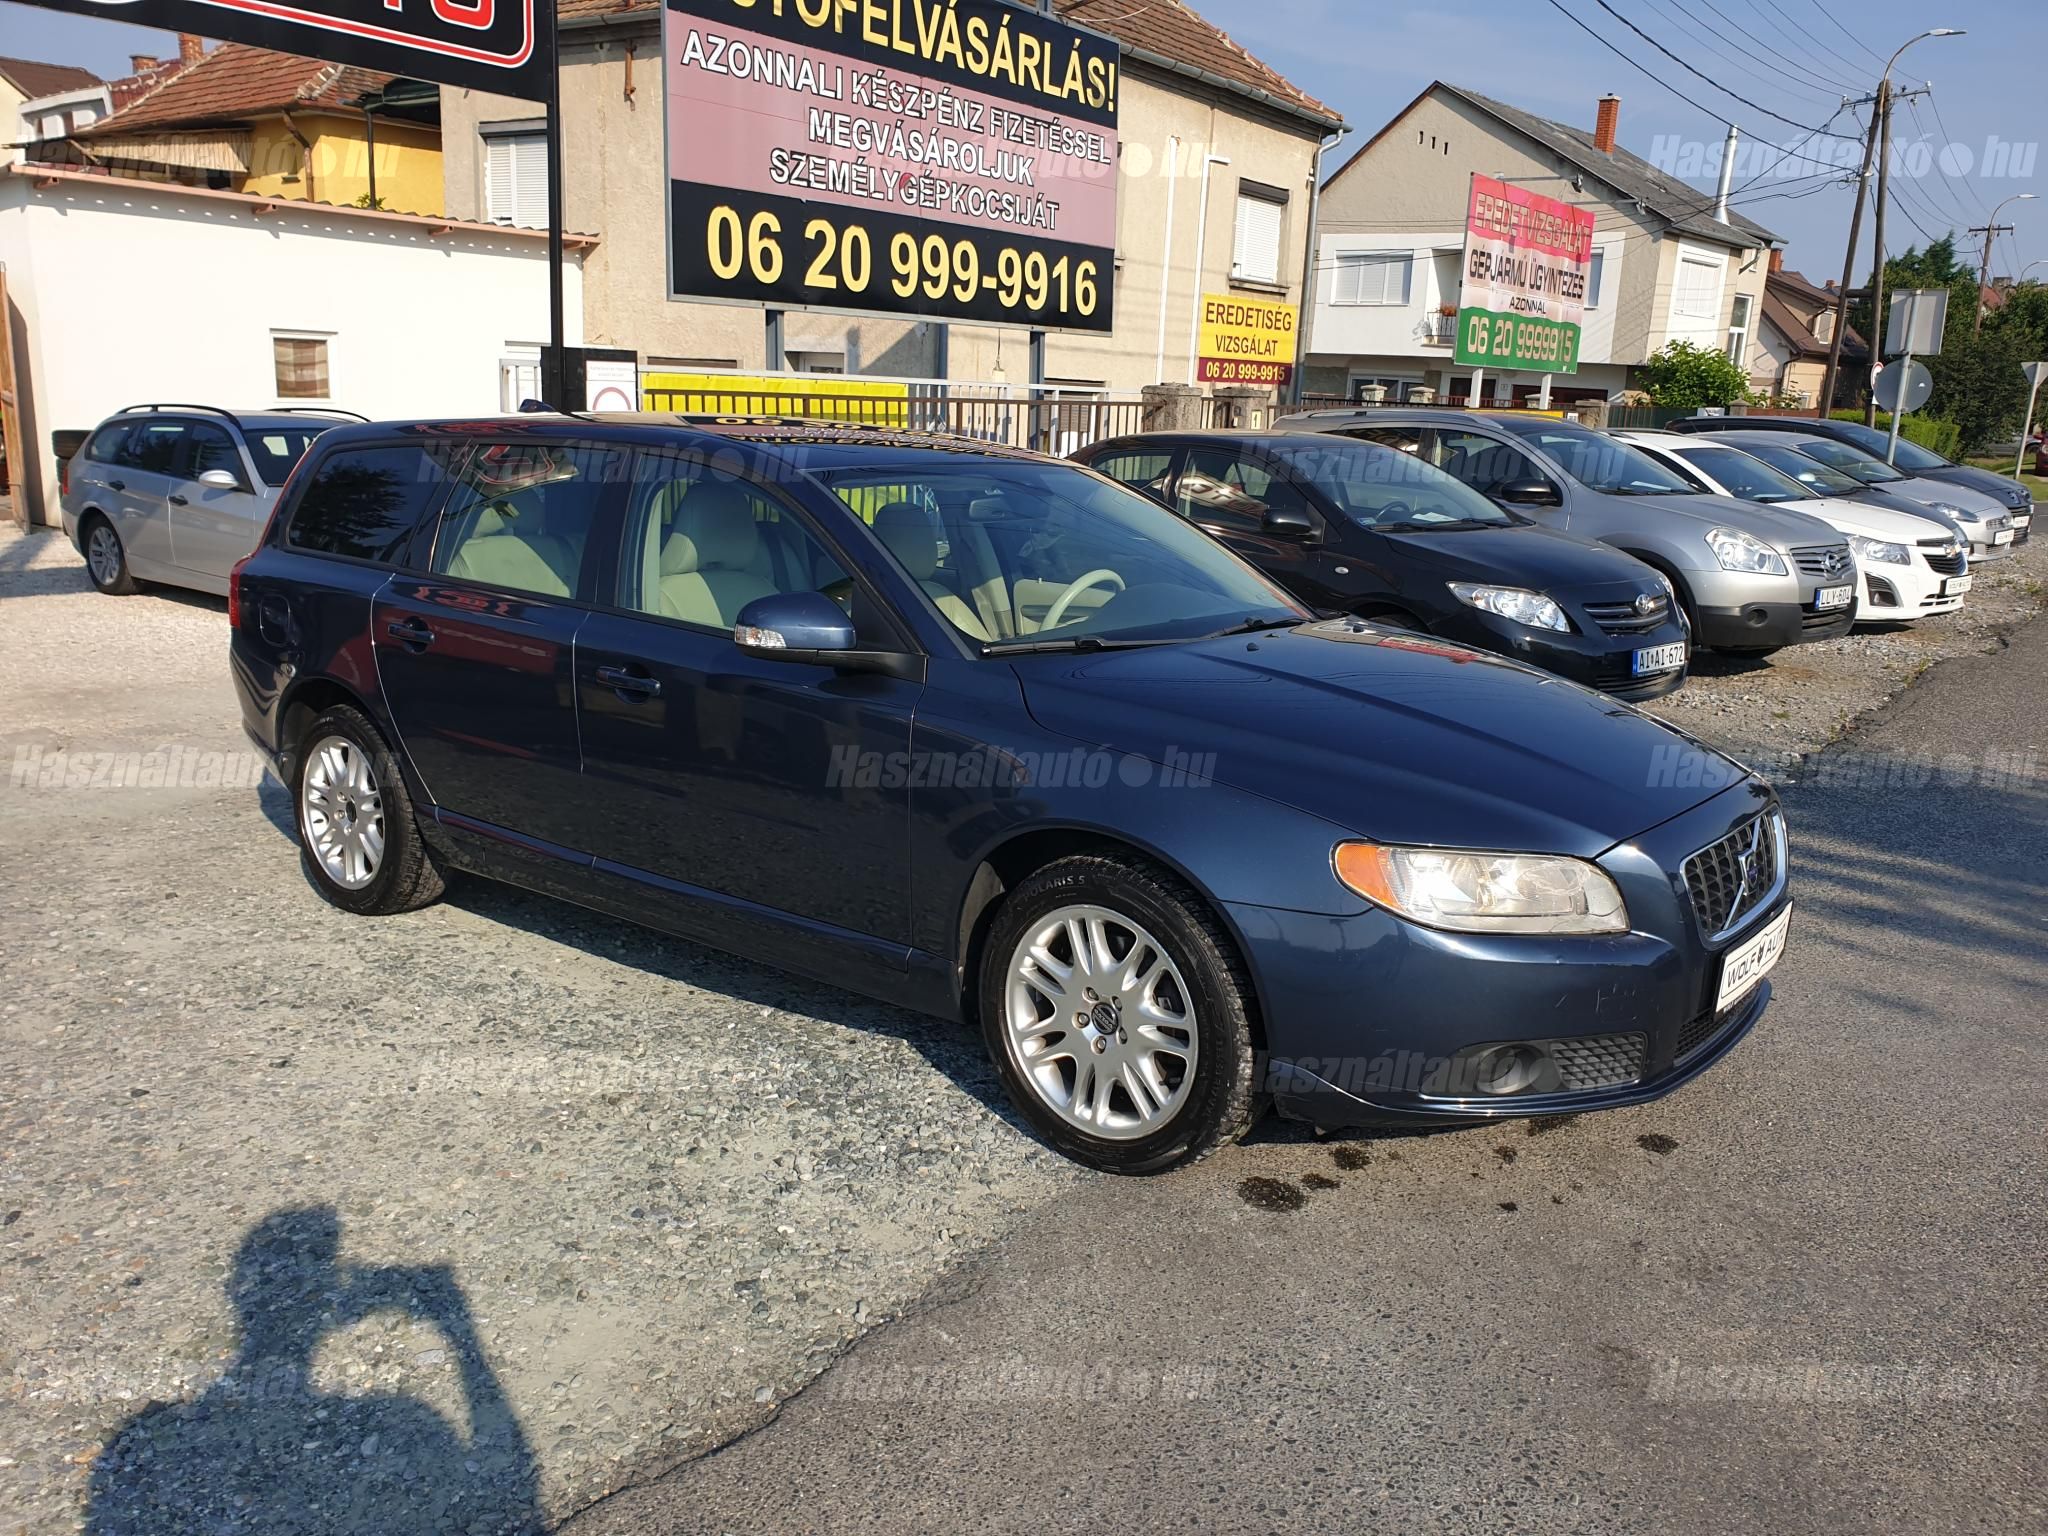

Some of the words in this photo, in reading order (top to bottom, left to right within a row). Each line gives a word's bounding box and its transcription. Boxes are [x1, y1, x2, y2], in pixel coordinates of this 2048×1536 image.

[681, 29, 843, 101] AZONNALI
[851, 69, 984, 134] KÉSZPÉNZ
[989, 108, 1112, 165] FIZETÉSSEL
[808, 107, 1034, 187] MEGVÁSÁROLJUK
[769, 147, 1060, 231] SZEMÉLYGÉPKOCSIJÁT
[706, 205, 785, 285] 06
[803, 218, 872, 293] 20
[889, 232, 1098, 317] 999-9916
[1205, 301, 1292, 332] EREDETISÉG
[1509, 296, 1547, 315] AZONNAL
[1215, 333, 1278, 357] VIZSGÁLAT
[1467, 315, 1489, 355] 06
[1492, 319, 1513, 357] 20
[1516, 322, 1575, 363] 9999915
[1206, 361, 1220, 378] 06
[1222, 362, 1236, 379] 20
[1238, 363, 1285, 381] 999-9915
[1727, 951, 1757, 988] WOLF
